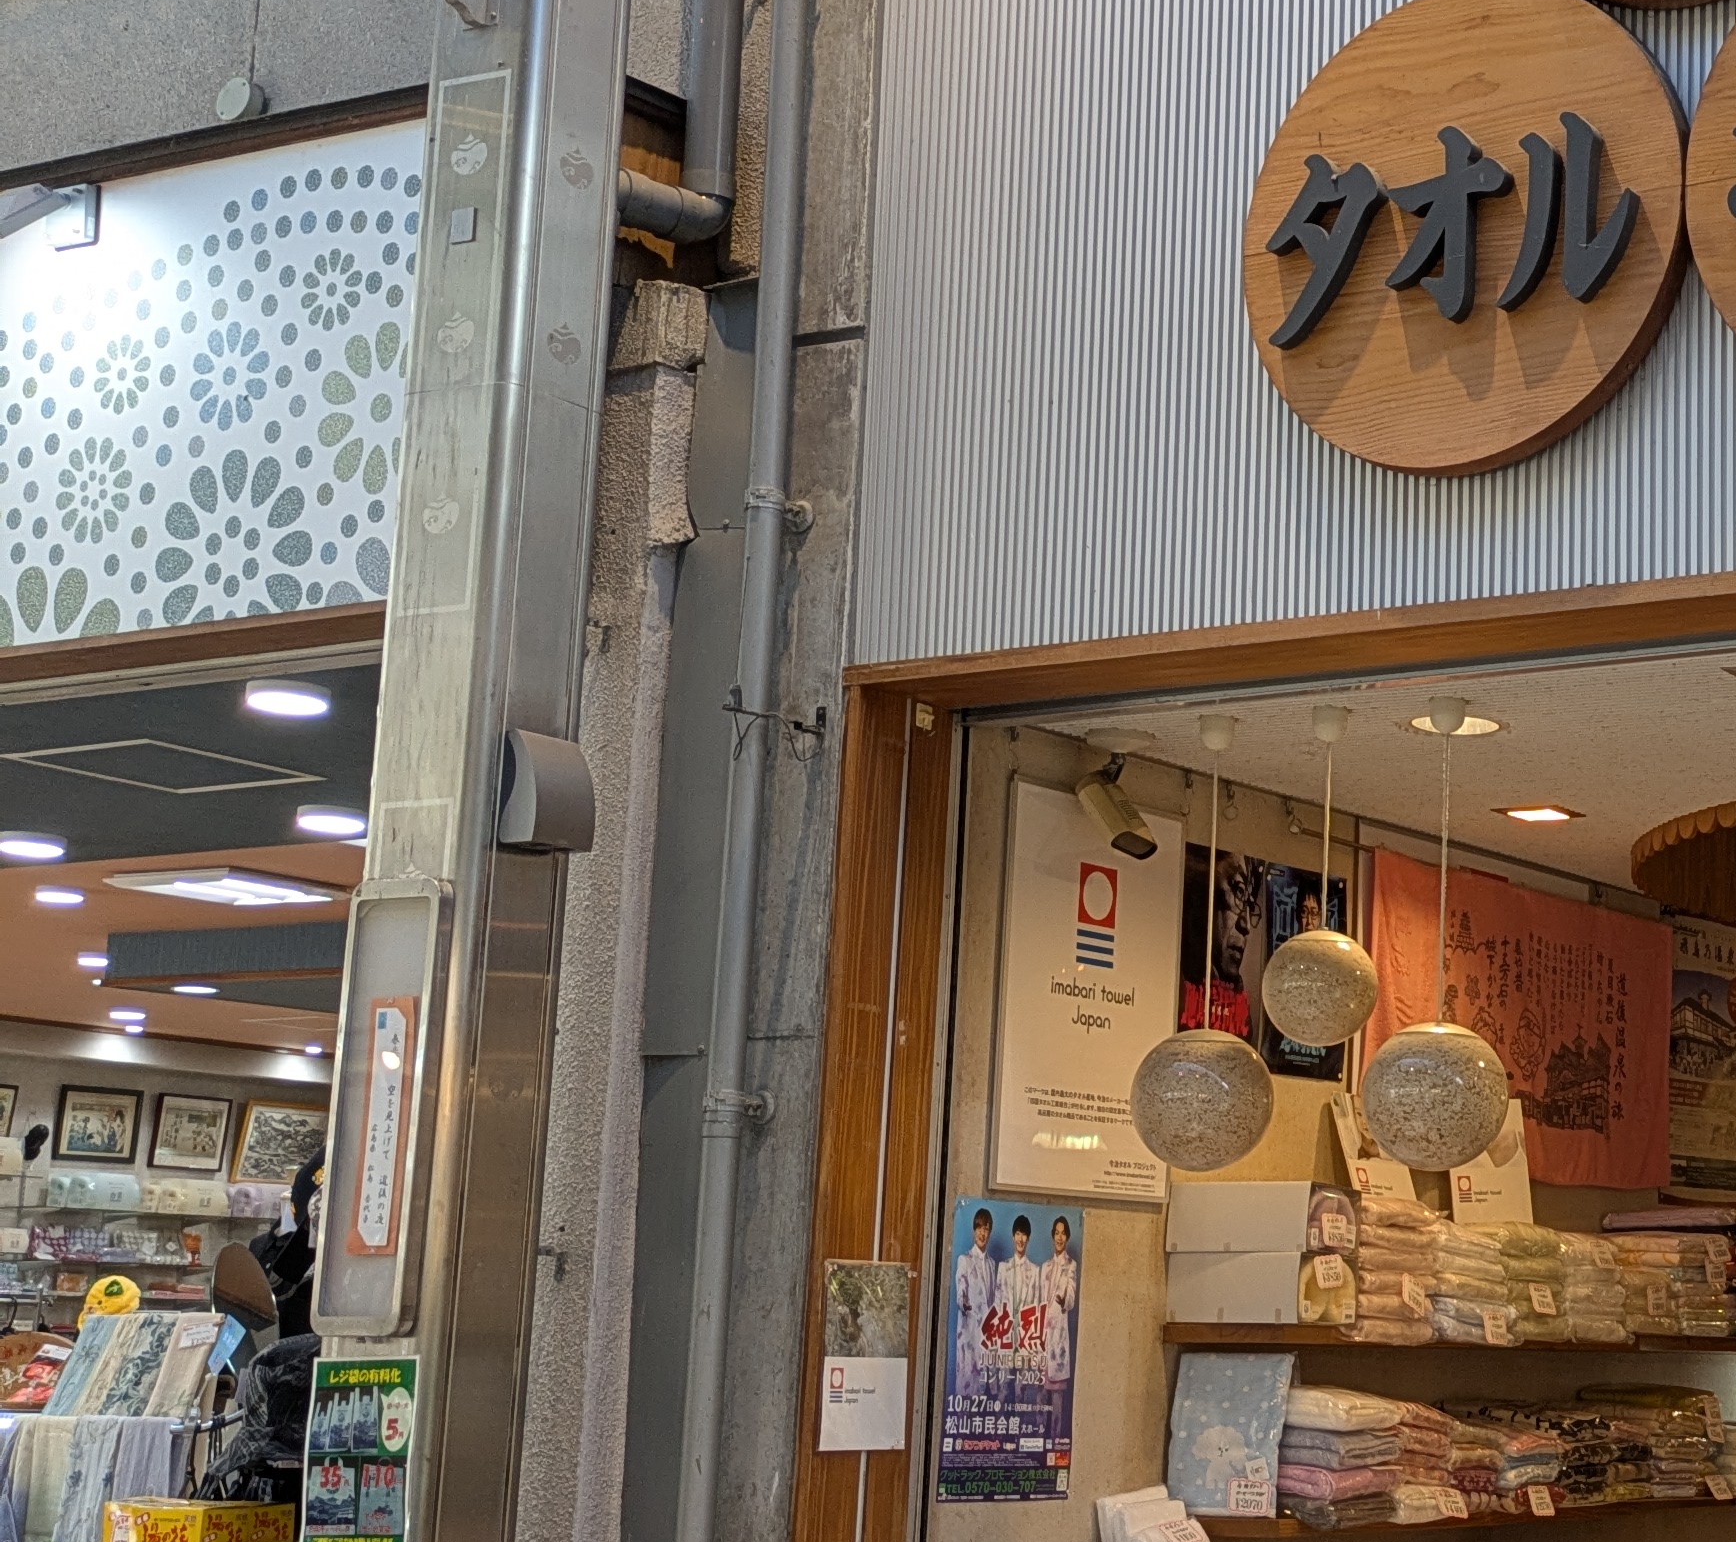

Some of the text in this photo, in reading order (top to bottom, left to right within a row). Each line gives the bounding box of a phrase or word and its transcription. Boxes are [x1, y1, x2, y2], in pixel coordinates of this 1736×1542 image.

[1263, 110, 1642, 352] タオル
[1050, 976, 1135, 1007] imabari towel
[1071, 1004, 1111, 1034] Japan
[383, 1084, 397, 1160] 空を見上げて
[980, 1301, 1048, 1353] 純烈
[979, 1352, 1048, 1369] JUNRETSU
[329, 1368, 402, 1384] レジ袋の有料化
[944, 1415, 1021, 1435] 松山市民会館
